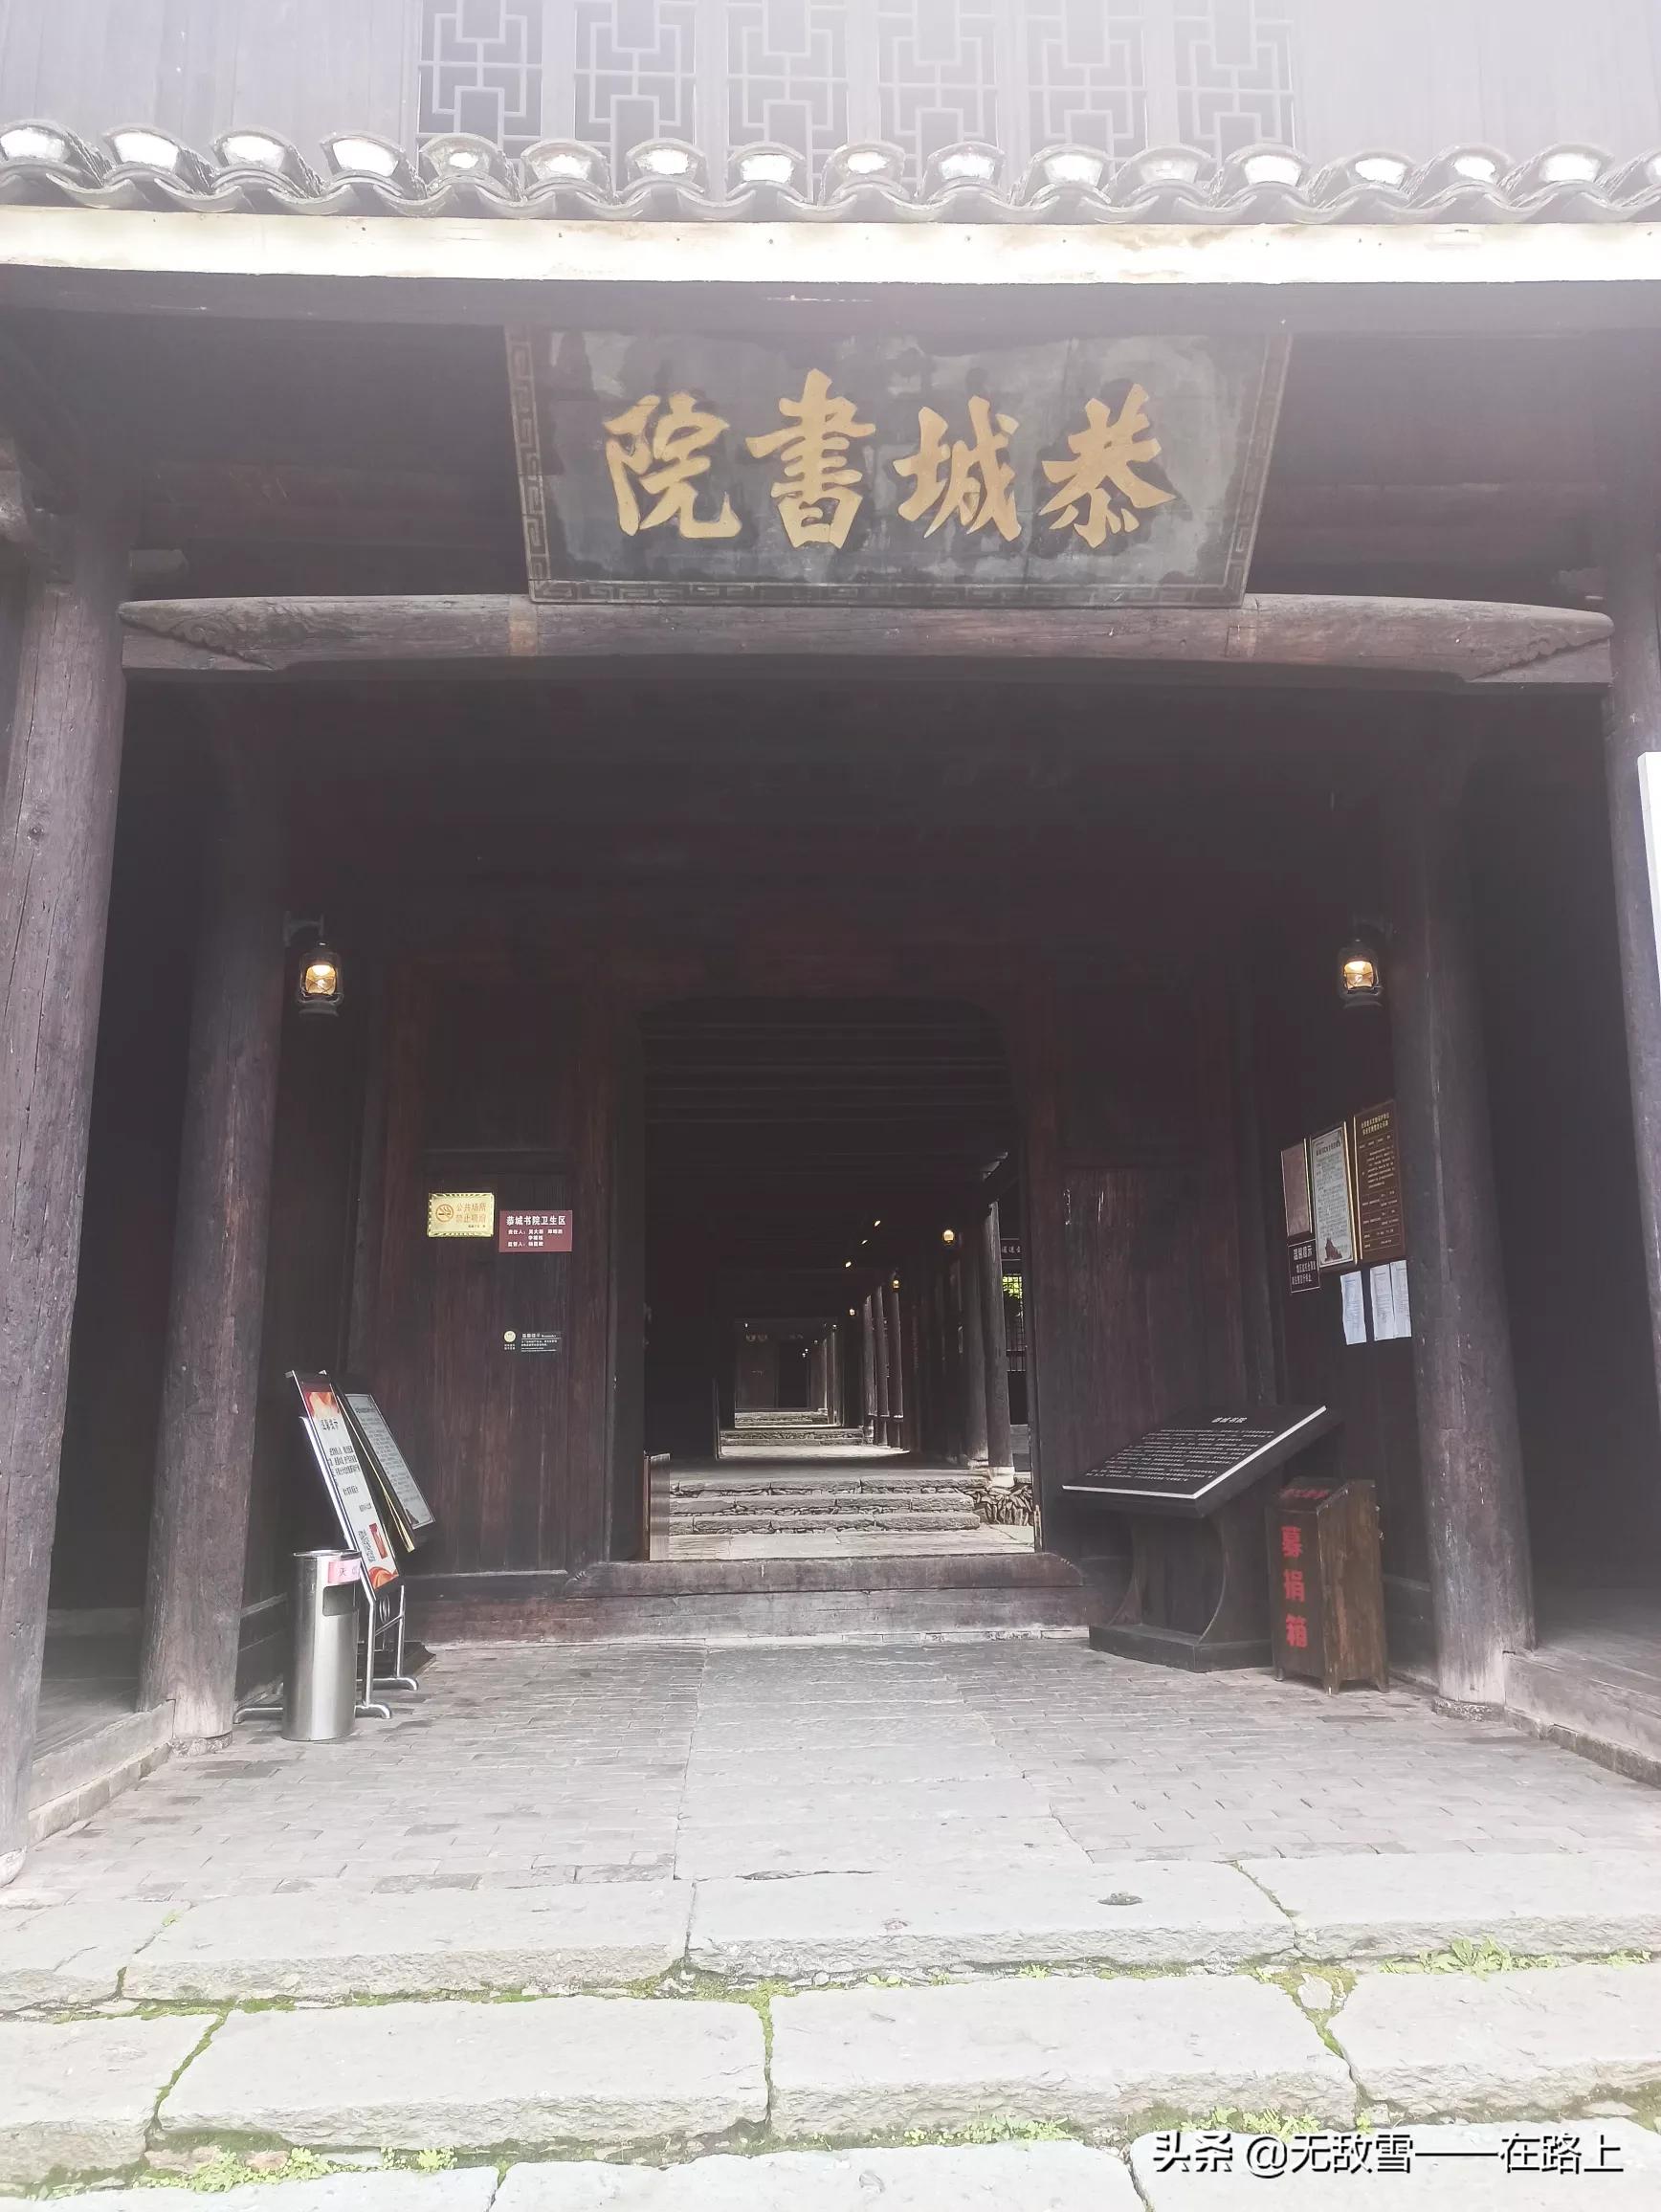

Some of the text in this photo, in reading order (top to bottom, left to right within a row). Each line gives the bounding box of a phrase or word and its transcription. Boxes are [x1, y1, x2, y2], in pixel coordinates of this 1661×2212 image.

[506, 1215, 566, 1226] 恭城书院卫生区
